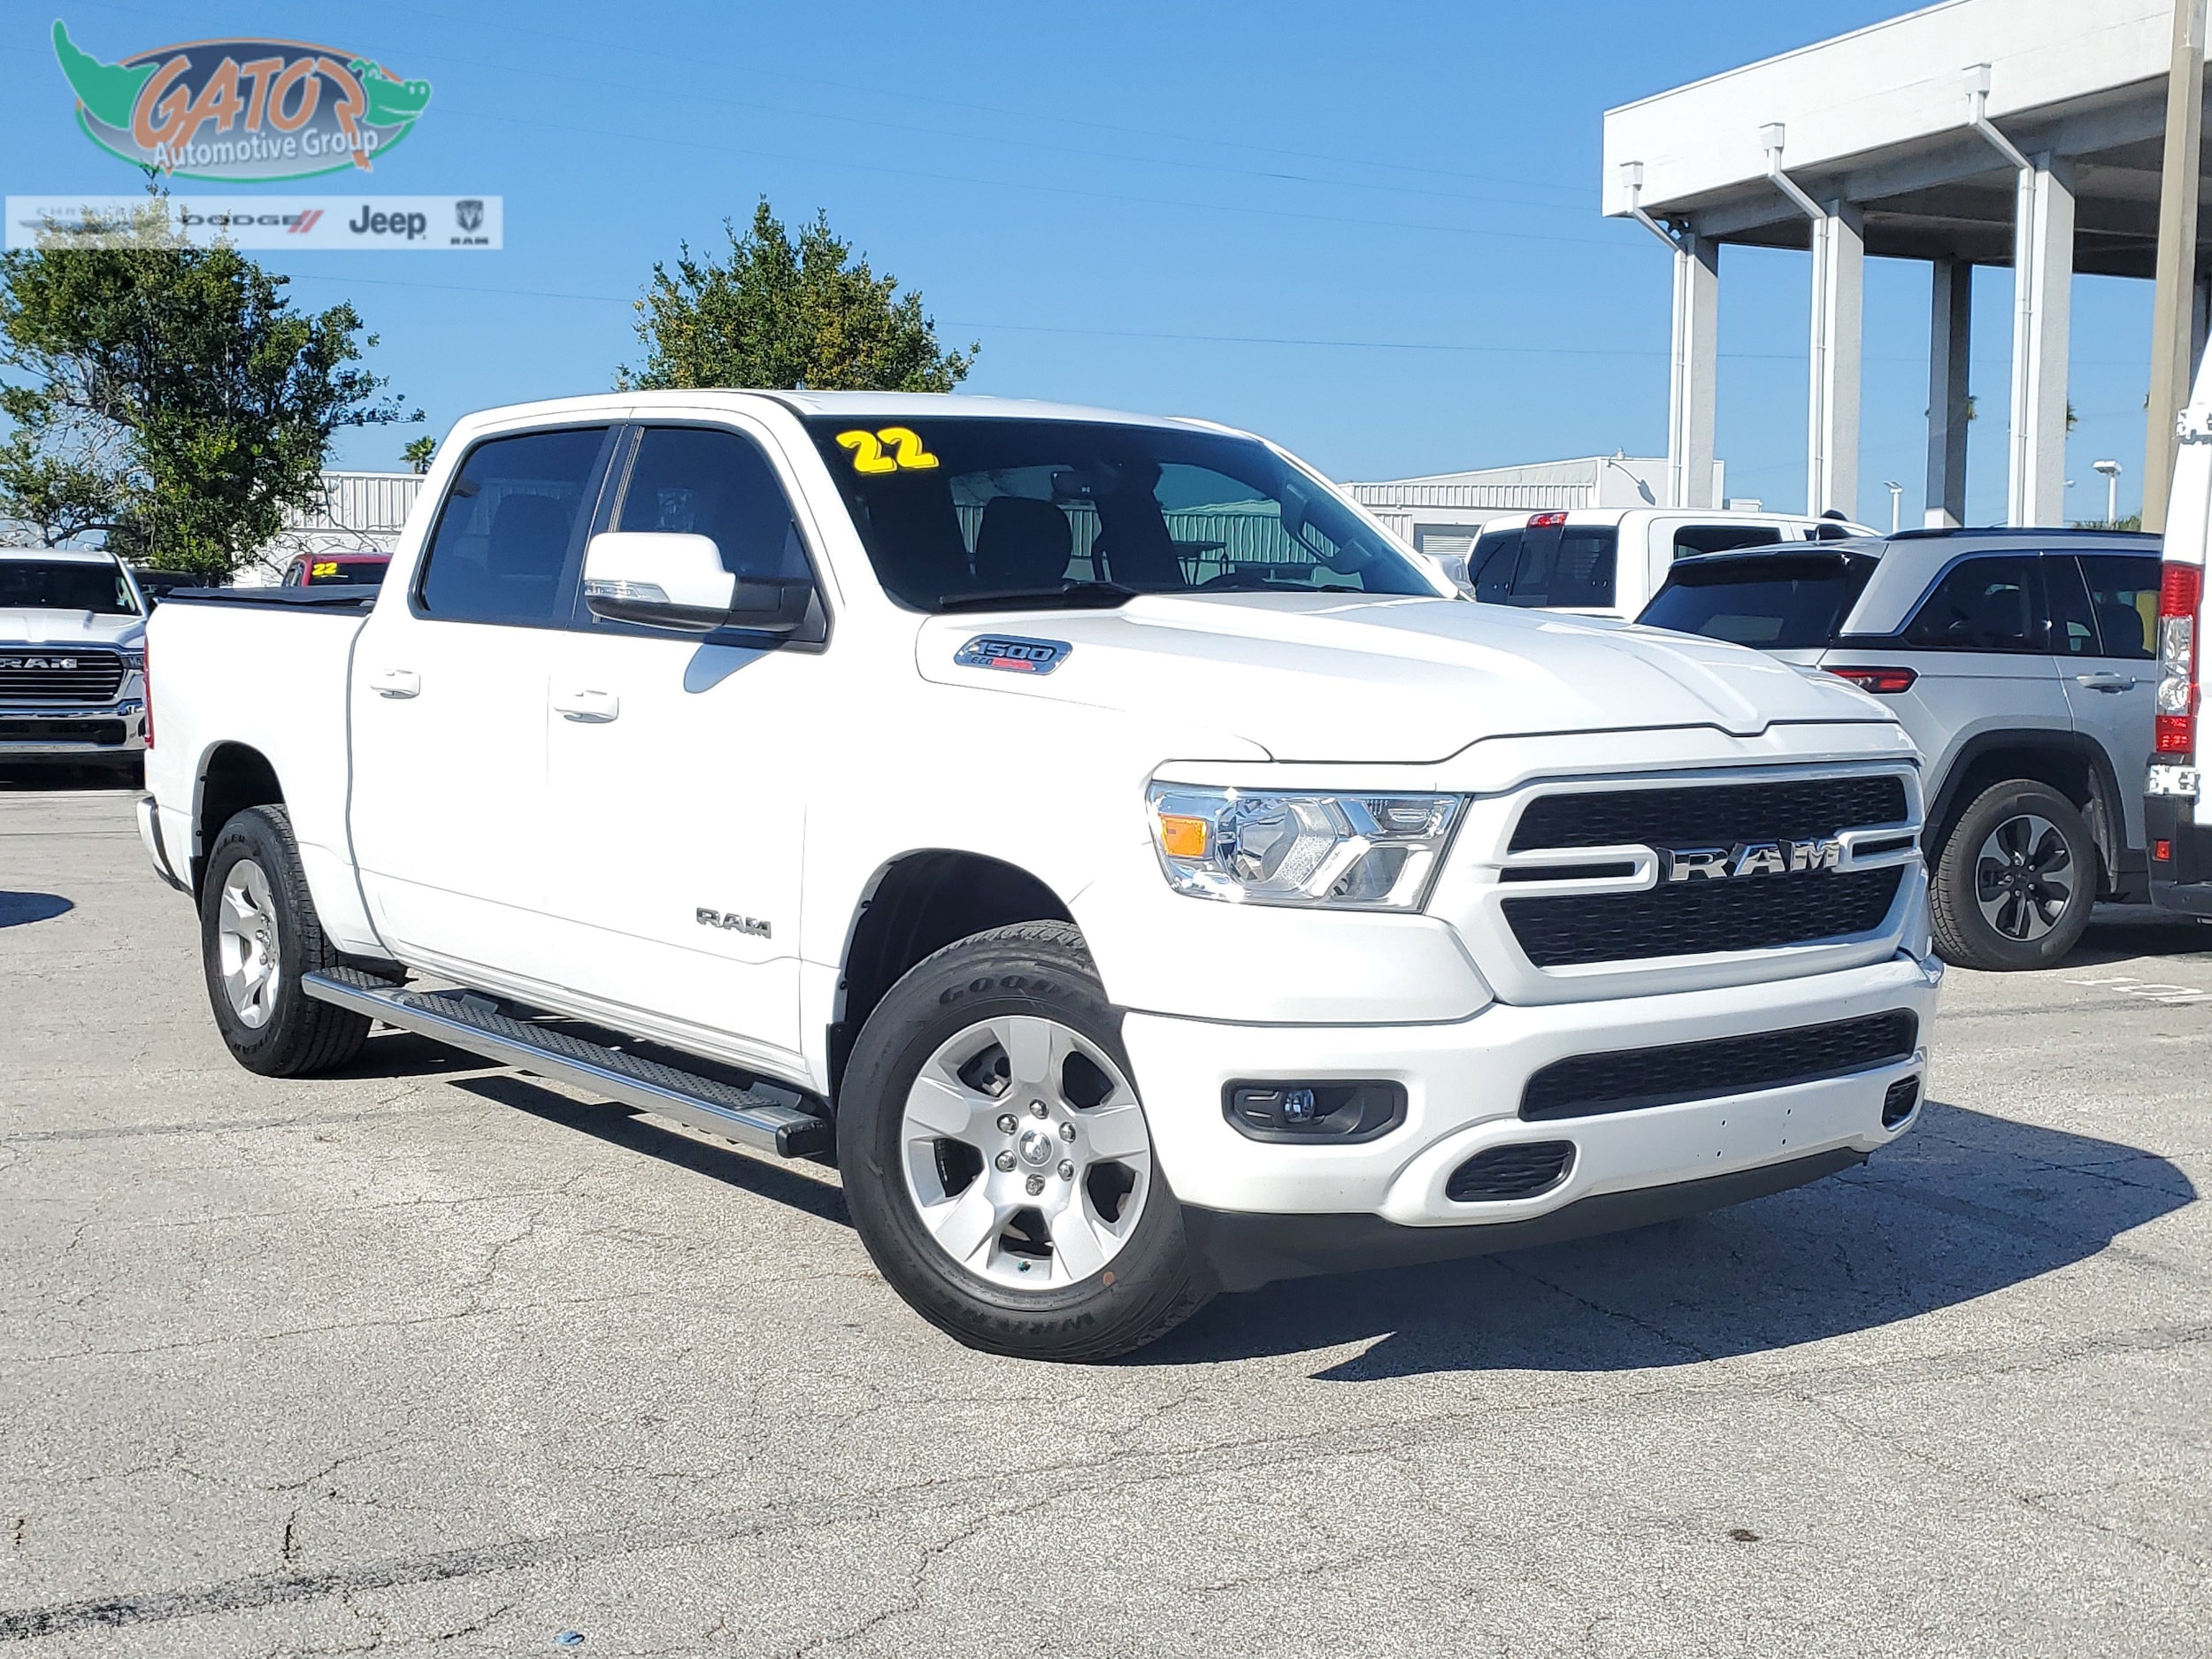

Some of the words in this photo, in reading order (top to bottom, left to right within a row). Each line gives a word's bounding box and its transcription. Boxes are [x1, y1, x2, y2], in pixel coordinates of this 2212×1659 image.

[836, 427, 940, 473] 22
[312, 562, 338, 576] 22
[975, 641, 1054, 661] 1500
[1658, 837, 1840, 881] RAM
[696, 907, 772, 940] RAM
